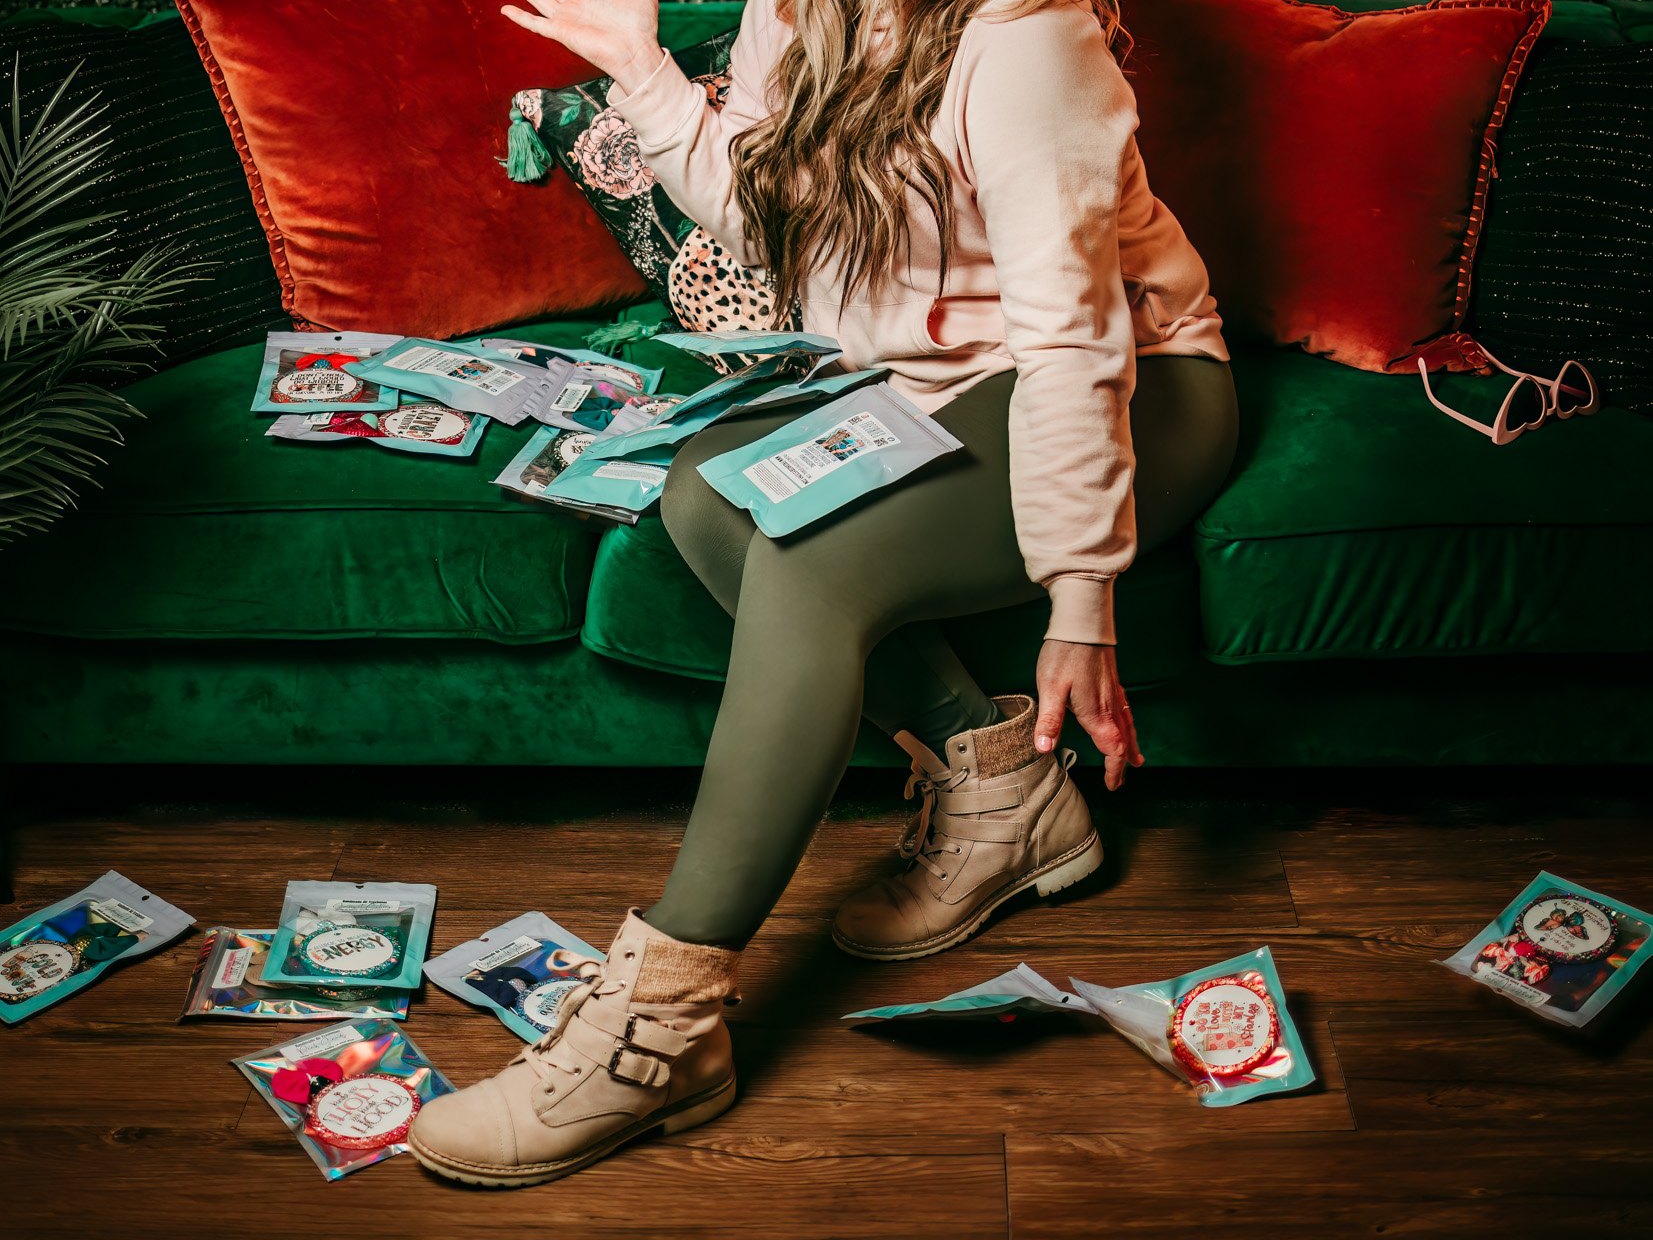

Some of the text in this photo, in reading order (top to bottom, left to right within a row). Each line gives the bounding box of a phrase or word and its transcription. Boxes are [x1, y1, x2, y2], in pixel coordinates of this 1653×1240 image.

[406, 411, 444, 438] CRAZY
[311, 935, 384, 962] ENERGY
[1205, 1008, 1222, 1030] Love
[1221, 1001, 1234, 1023] WITH
[1241, 1003, 1260, 1040] Stanley
[329, 1082, 379, 1122] HOLY
[351, 1096, 402, 1134] HOOD
